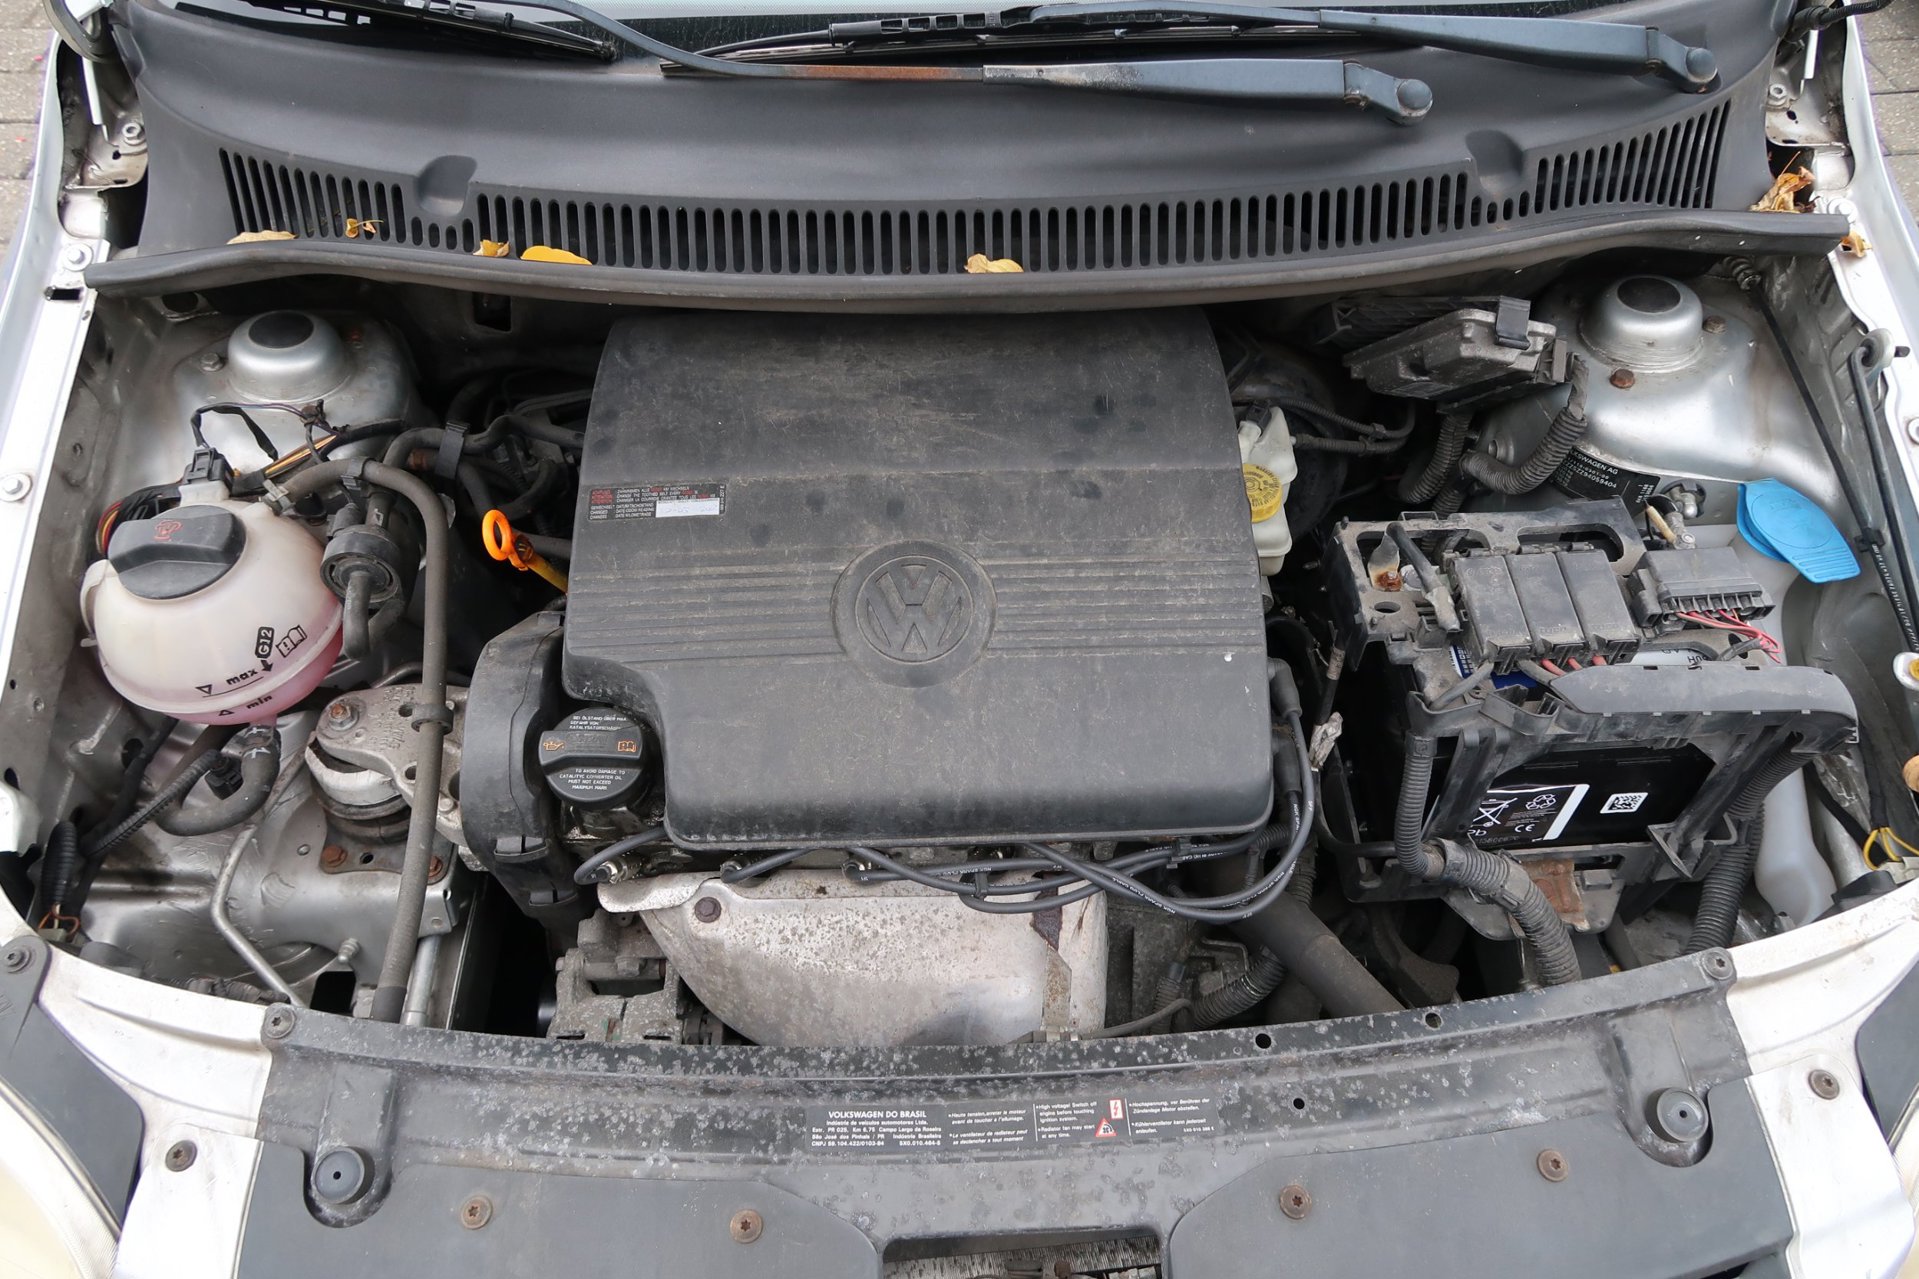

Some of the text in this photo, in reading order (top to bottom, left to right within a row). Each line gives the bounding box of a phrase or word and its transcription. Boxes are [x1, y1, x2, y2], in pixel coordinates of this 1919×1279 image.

[1607, 467, 1619, 475] AG
[855, 554, 974, 665] VW
[258, 629, 272, 656] G12
[226, 668, 258, 686] max
[246, 696, 274, 710] min
[828, 1110, 884, 1119] VOLKSWAGEN
